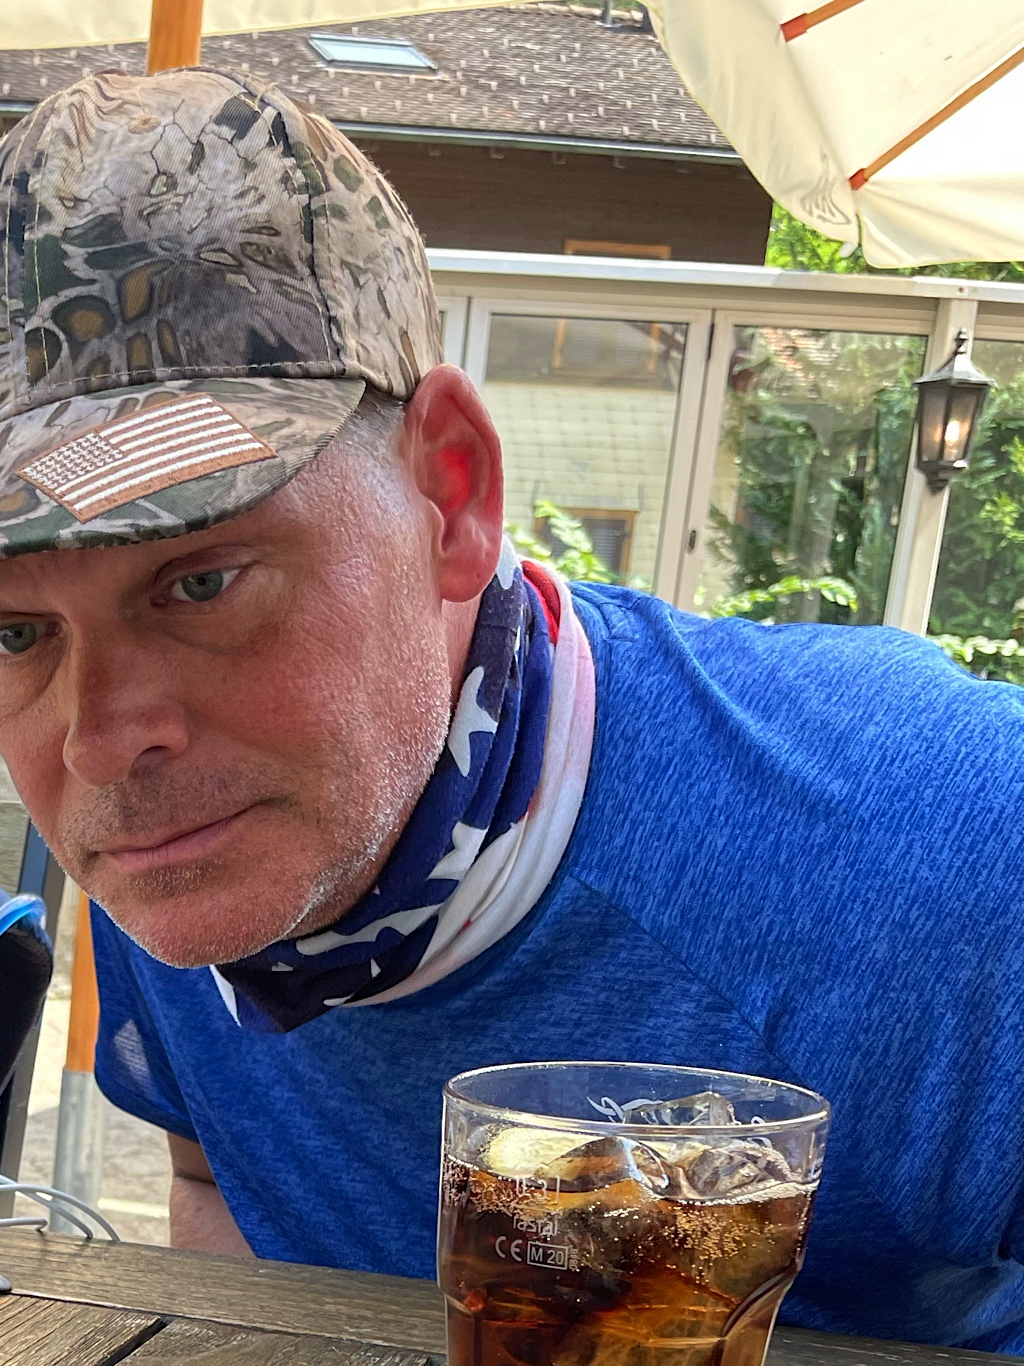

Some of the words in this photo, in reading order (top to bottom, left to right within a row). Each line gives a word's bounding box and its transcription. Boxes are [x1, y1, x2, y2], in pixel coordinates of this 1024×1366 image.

[495, 1235, 523, 1262] CE
[530, 1246, 543, 1262] M
[546, 1249, 564, 1266] 20
